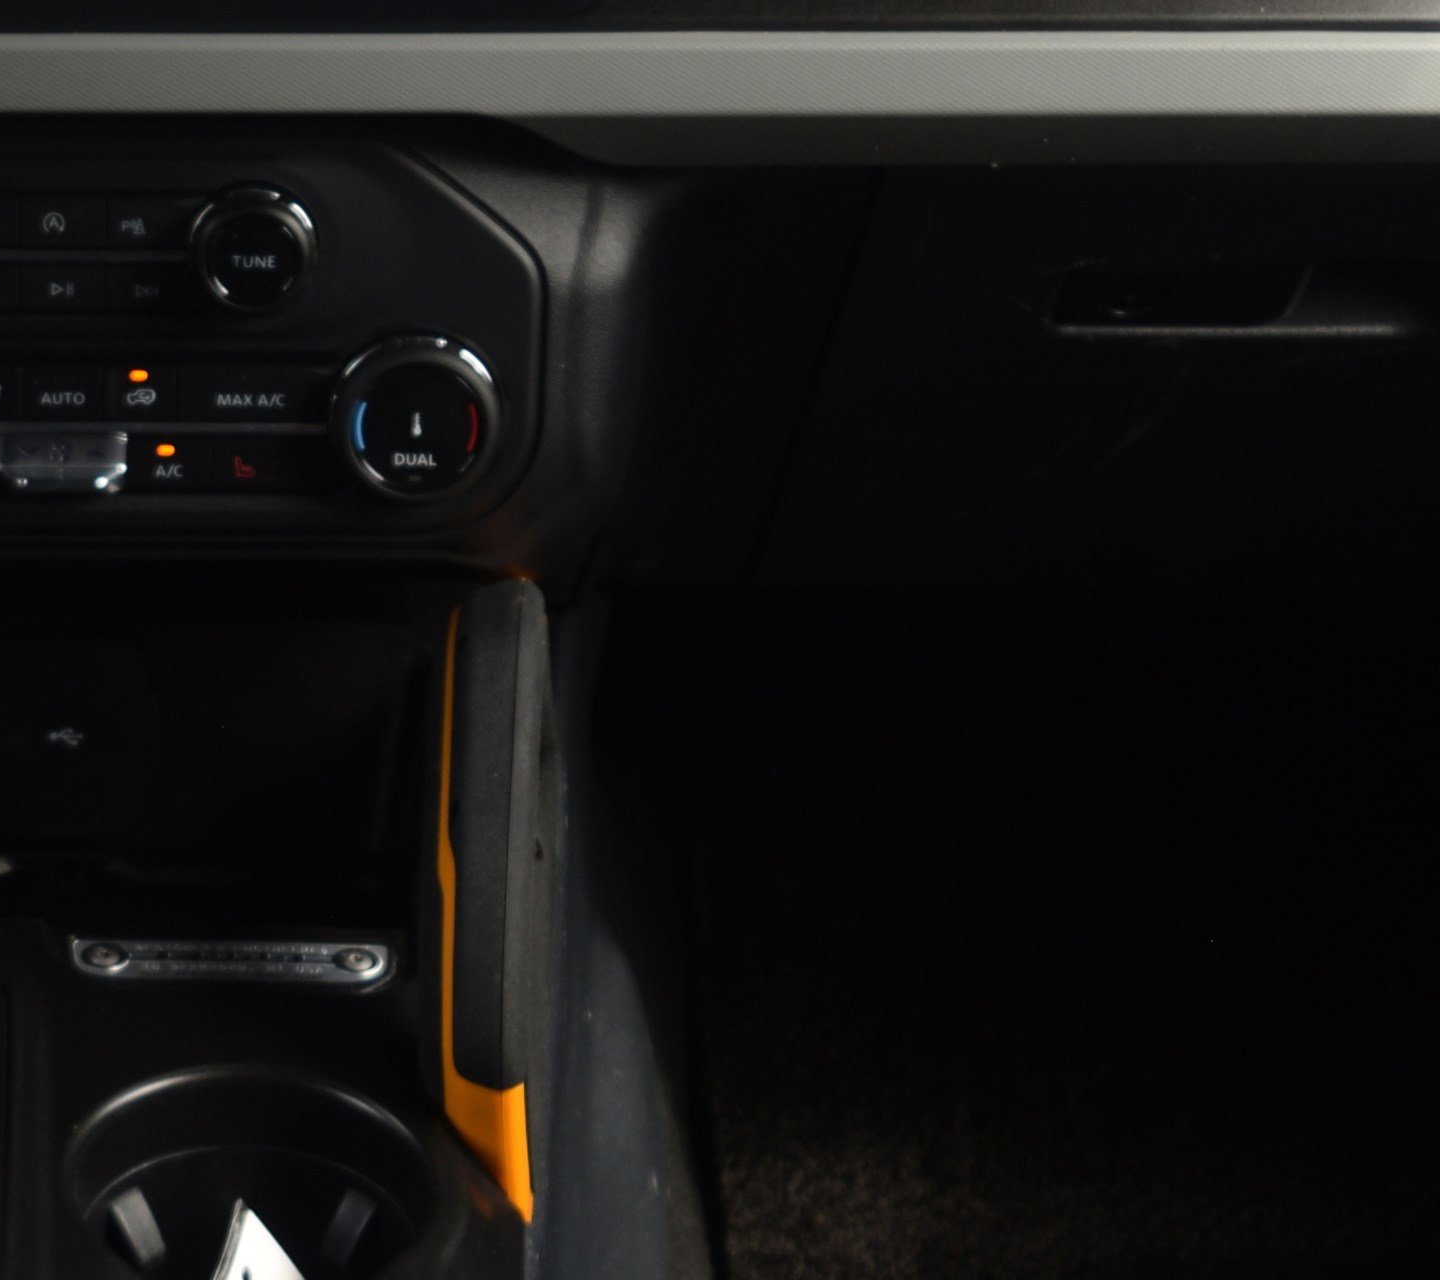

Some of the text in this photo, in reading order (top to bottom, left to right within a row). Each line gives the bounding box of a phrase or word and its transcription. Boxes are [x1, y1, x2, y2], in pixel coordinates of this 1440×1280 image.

[231, 255, 278, 269] TUNE
[40, 392, 86, 406] AUTO
[217, 392, 286, 408] MAX A/C
[393, 452, 437, 467] DUAL
[155, 464, 184, 479] A/C
